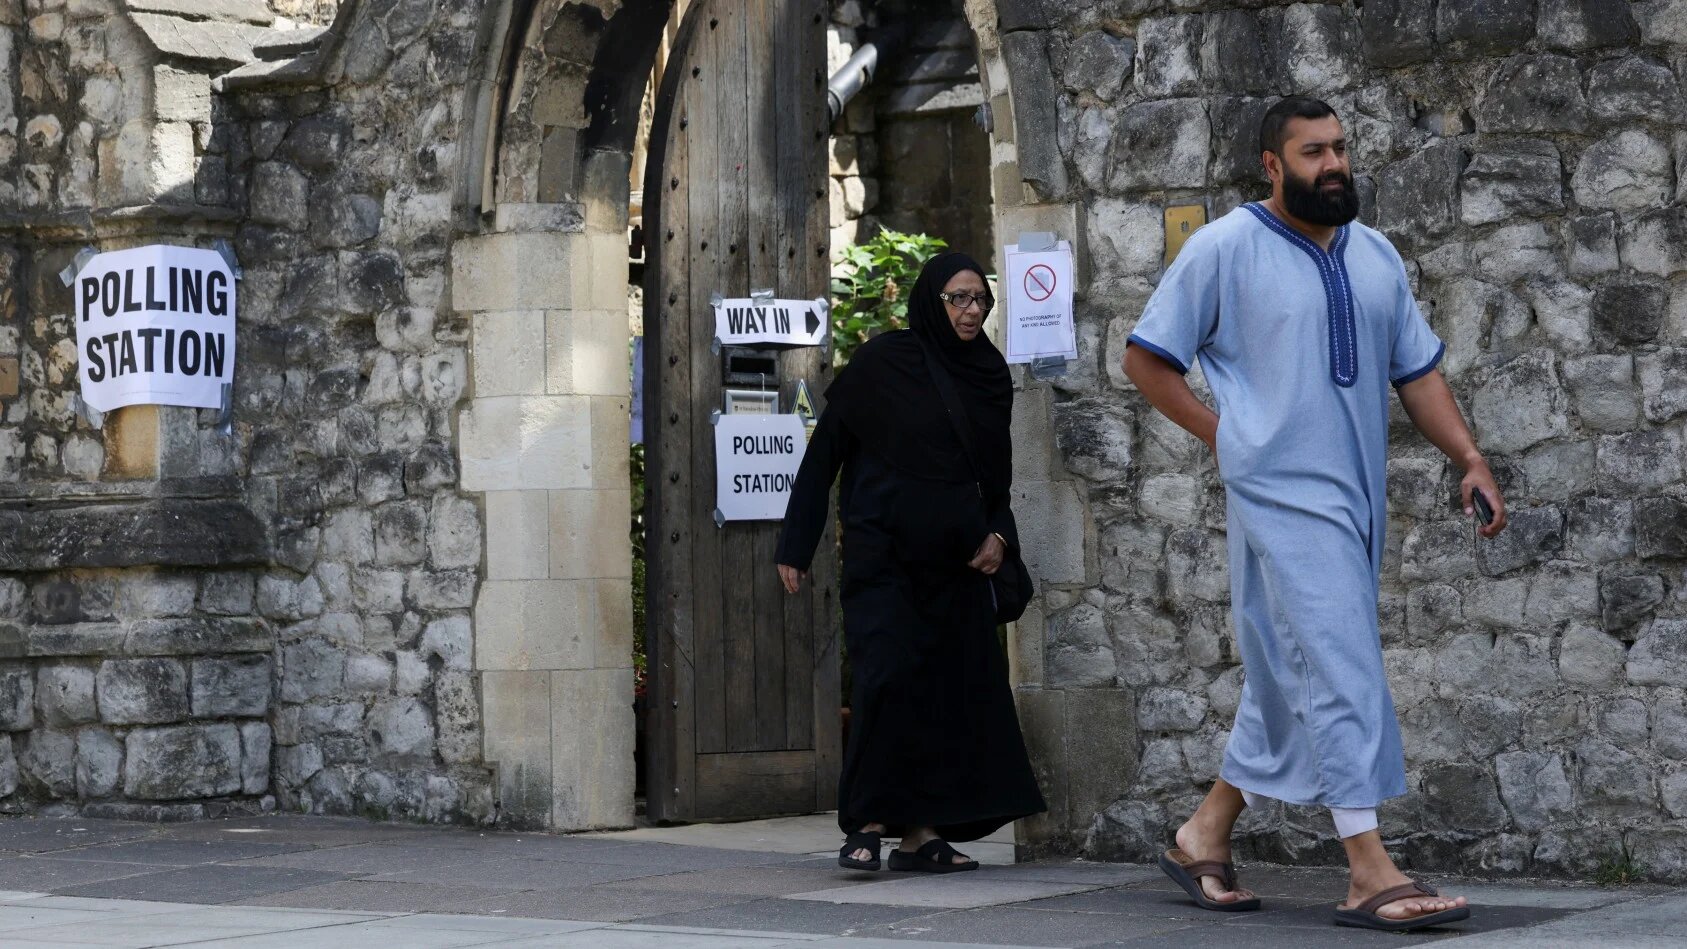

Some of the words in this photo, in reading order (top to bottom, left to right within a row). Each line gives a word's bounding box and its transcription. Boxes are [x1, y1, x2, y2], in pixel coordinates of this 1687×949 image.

[82, 266, 228, 322] POLLING
[727, 307, 767, 334] WAY
[773, 308, 791, 334] IN
[86, 328, 225, 383] STATION
[733, 435, 793, 454] POLLING
[733, 473, 795, 493] STATION
